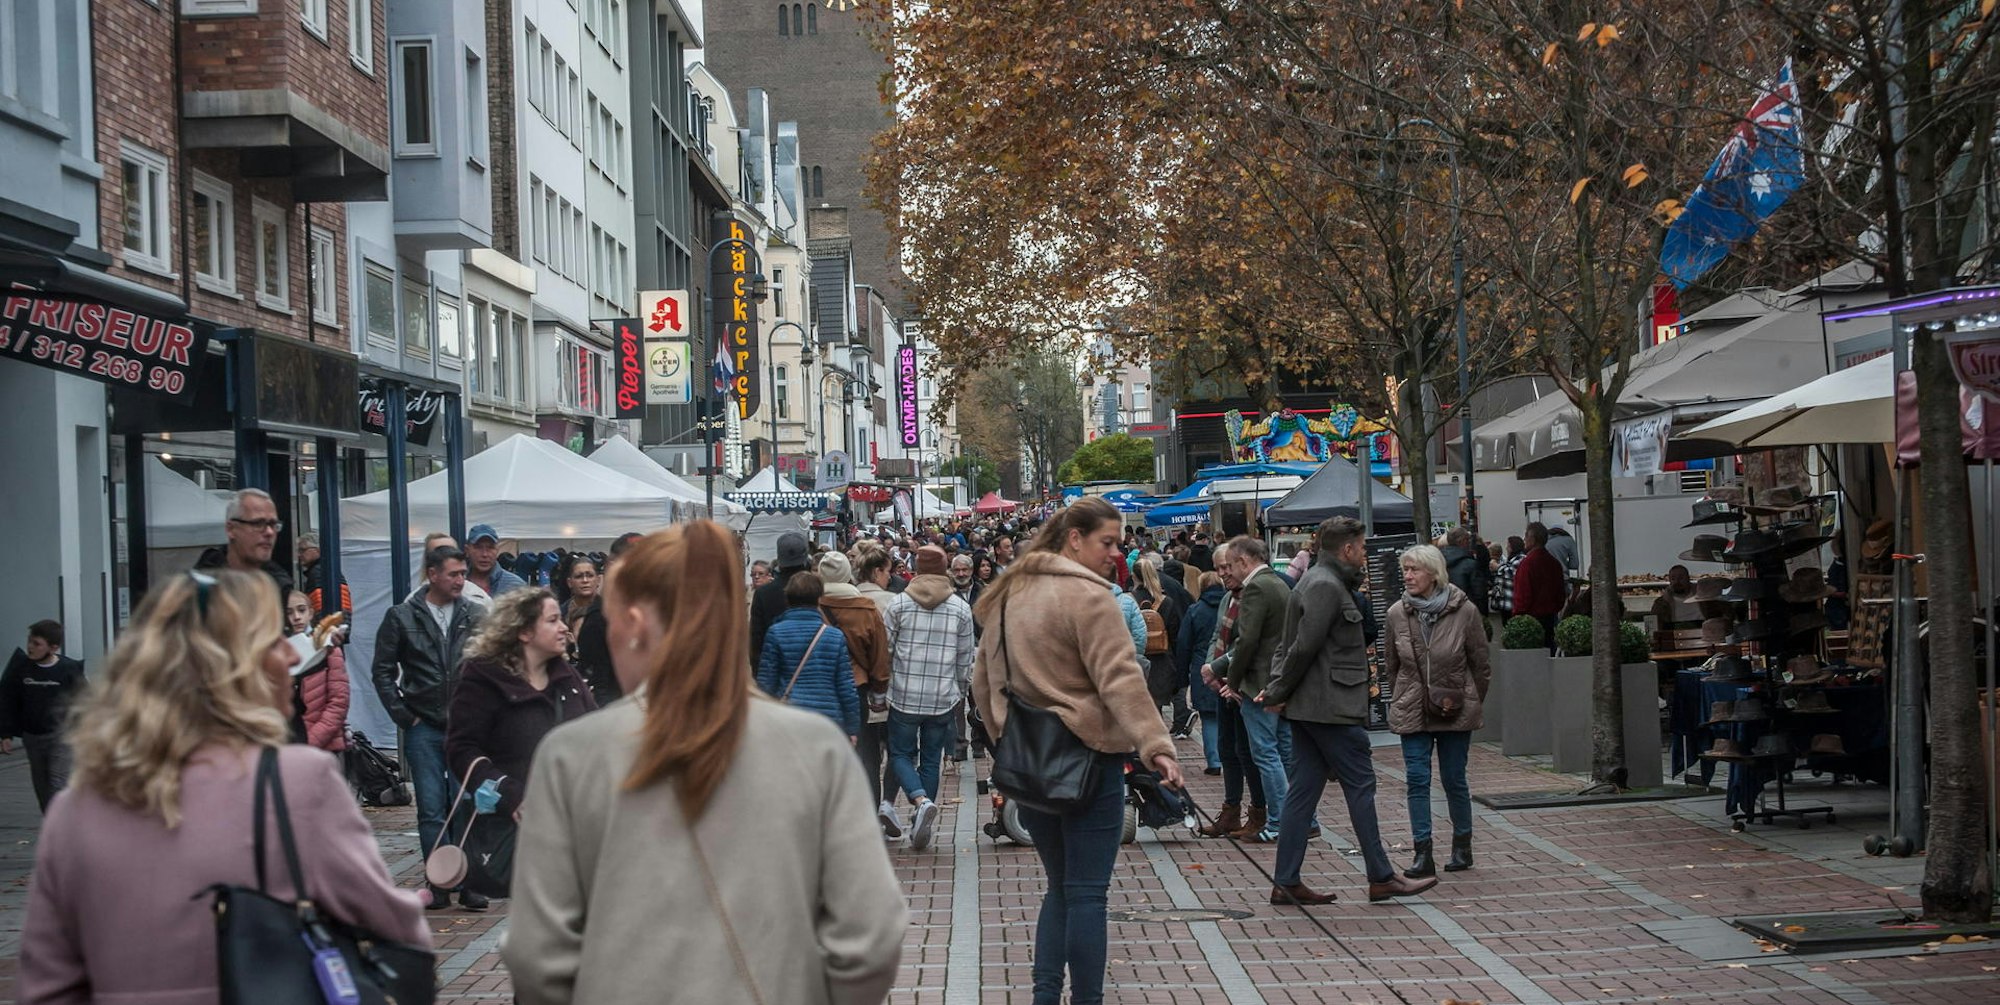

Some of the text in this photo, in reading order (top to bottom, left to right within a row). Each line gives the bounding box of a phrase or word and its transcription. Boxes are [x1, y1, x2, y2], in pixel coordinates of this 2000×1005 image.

[3, 282, 194, 366] FRISEUR
[730, 222, 749, 419] bäckerei
[31, 335, 86, 369] 312
[88, 351, 143, 384] 268
[148, 365, 185, 395] 90
[617, 325, 642, 411] Pieper
[358, 389, 440, 425] Tredy
[735, 497, 818, 509] BACKFISCH
